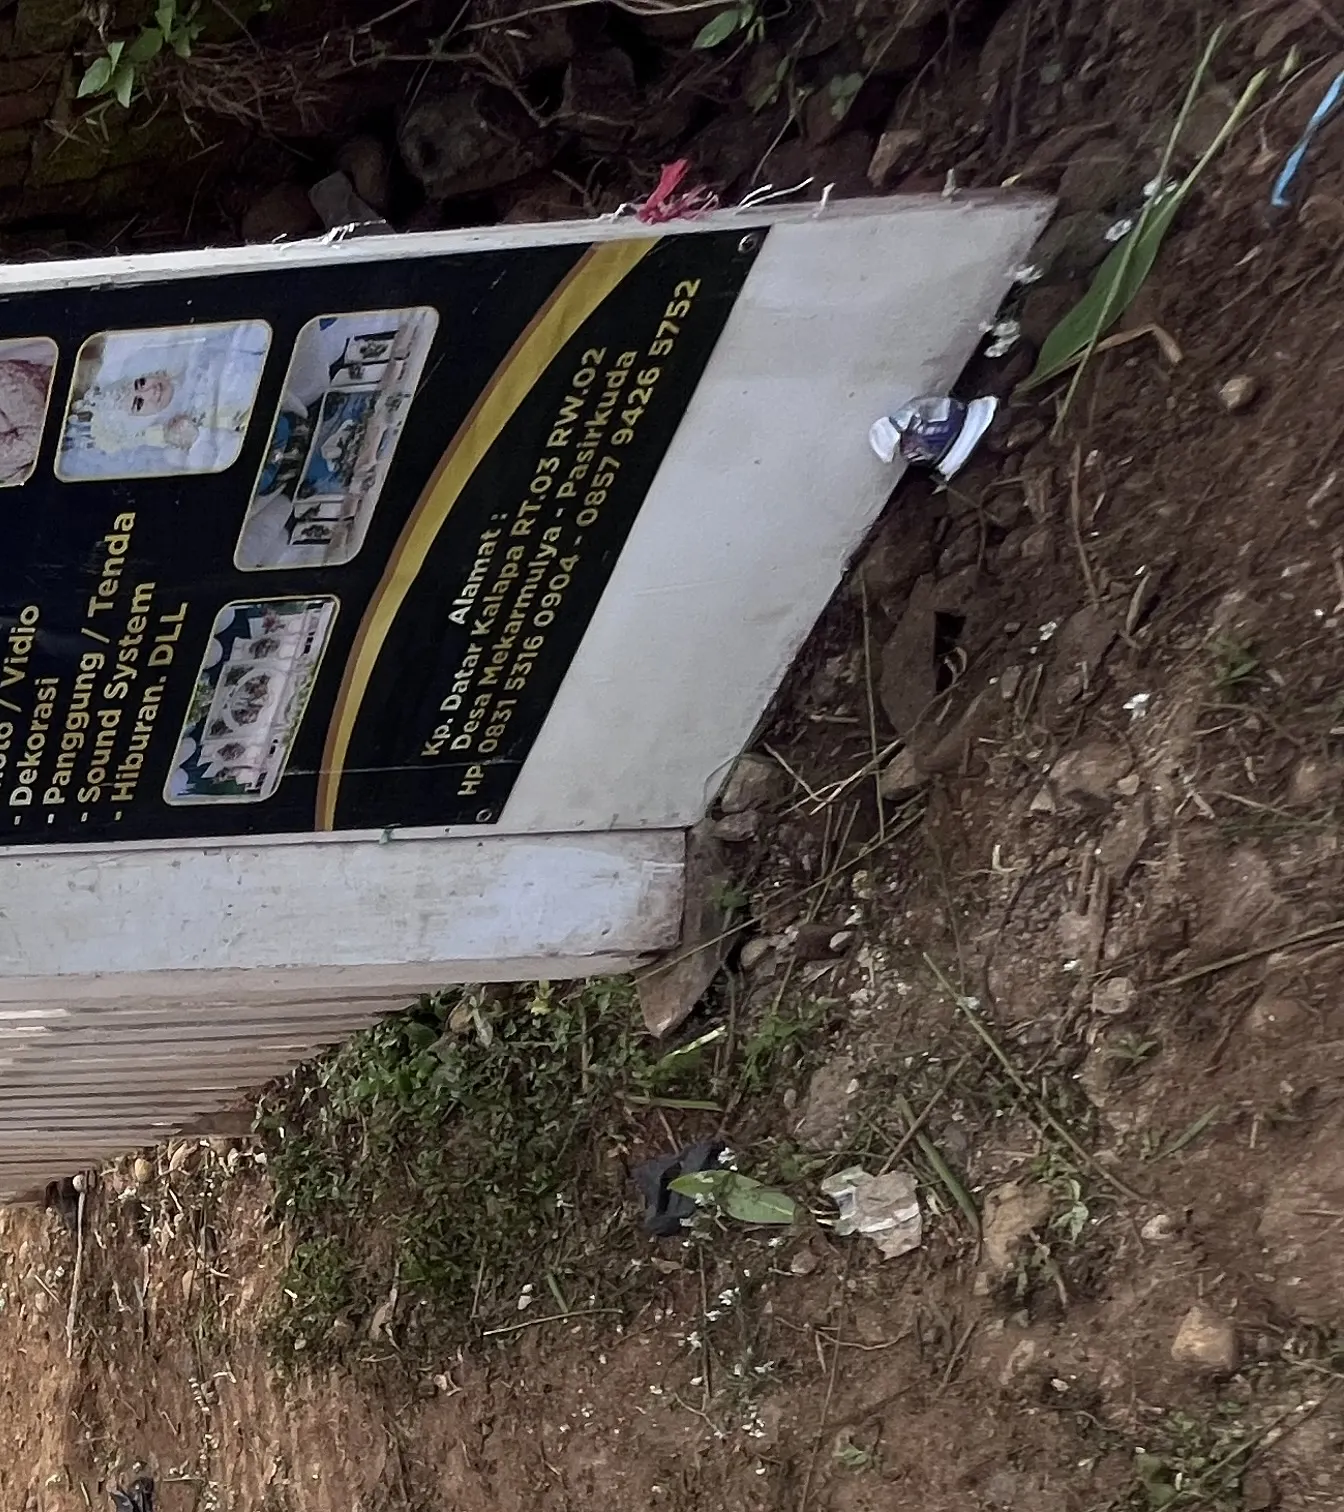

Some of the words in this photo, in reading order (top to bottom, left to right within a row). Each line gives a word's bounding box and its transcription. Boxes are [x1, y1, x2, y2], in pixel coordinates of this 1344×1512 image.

[420, 717, 454, 756] Kp.
[439, 642, 484, 711] Datar
[470, 545, 526, 635] Kalapa
[510, 456, 561, 536] RT.03
[545, 347, 608, 448] RW.02
[447, 527, 502, 624] Alamat
[450, 692, 494, 750] Desa
[477, 526, 563, 685] Mekarmulya
[555, 350, 638, 498] Pasirkuda
[477, 698, 518, 753] 0831
[503, 635, 545, 690] 5316
[533, 554, 580, 627] 0904
[575, 456, 622, 527] 0857
[610, 366, 661, 445] 9426
[647, 278, 702, 356] 5752
[0, 604, 40, 688] Vidio
[8, 677, 60, 806] Dekorasi
[42, 652, 106, 805] Panggung
[86, 511, 137, 618] Tenda
[76, 709, 123, 803] Sound
[103, 581, 157, 699] System
[110, 675, 167, 801] Hiburan.
[147, 601, 189, 666] DLL
